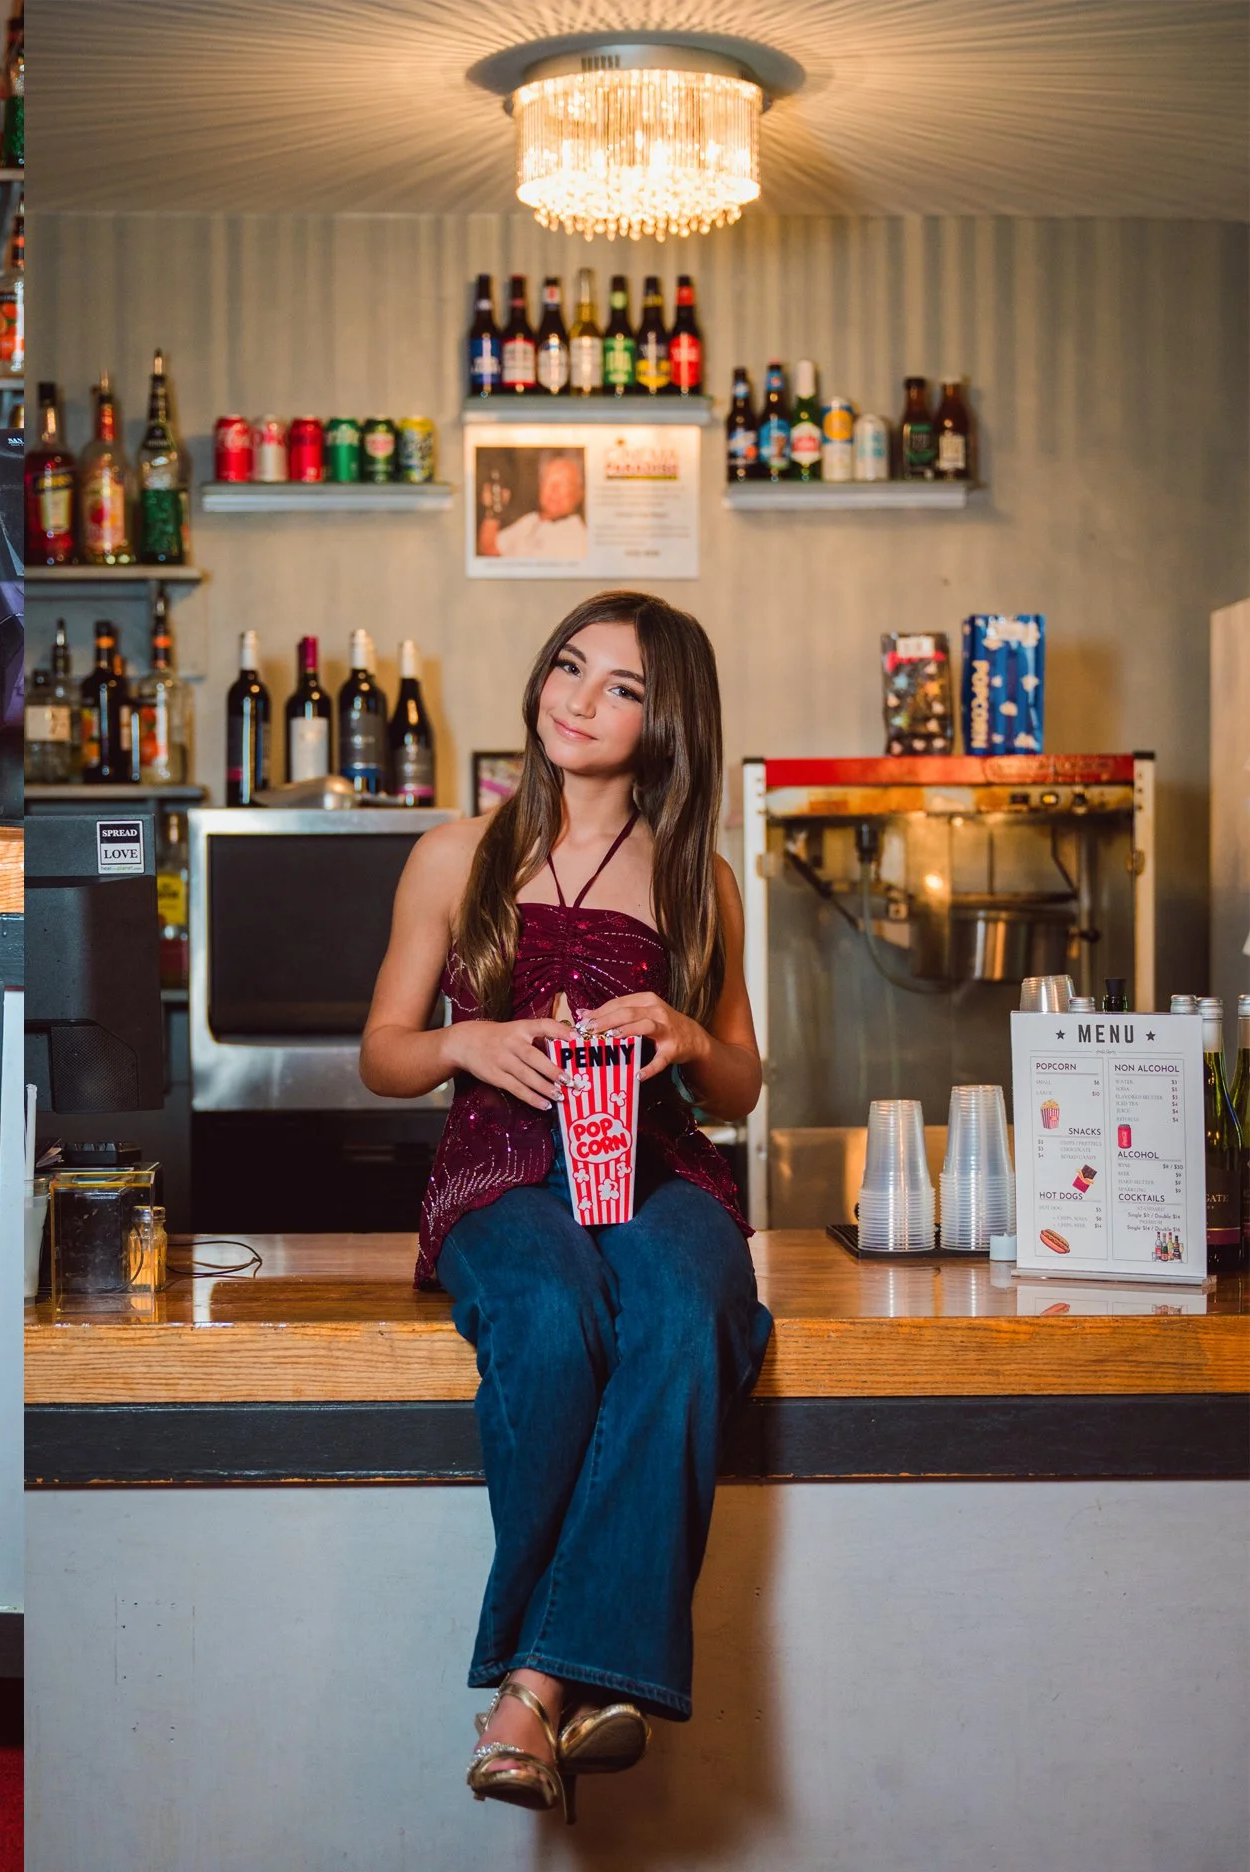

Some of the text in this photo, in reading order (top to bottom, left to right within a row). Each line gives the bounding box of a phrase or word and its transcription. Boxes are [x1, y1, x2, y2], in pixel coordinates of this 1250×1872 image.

[102, 829, 138, 837] SPREAD
[104, 849, 138, 859] LOVE
[1078, 1024, 1134, 1043] MENU
[561, 1043, 635, 1069] PENNY
[1036, 1062, 1077, 1070] POPCORN
[1137, 1064, 1180, 1073] ALCOHOL
[573, 1117, 613, 1142] POP
[1068, 1127, 1102, 1136] SNACKS
[576, 1133, 628, 1159] CORN
[1118, 1150, 1159, 1159] ALCOHOL
[1039, 1191, 1083, 1200] HOT DOGS
[1118, 1193, 1165, 1202] COCKTAILS
